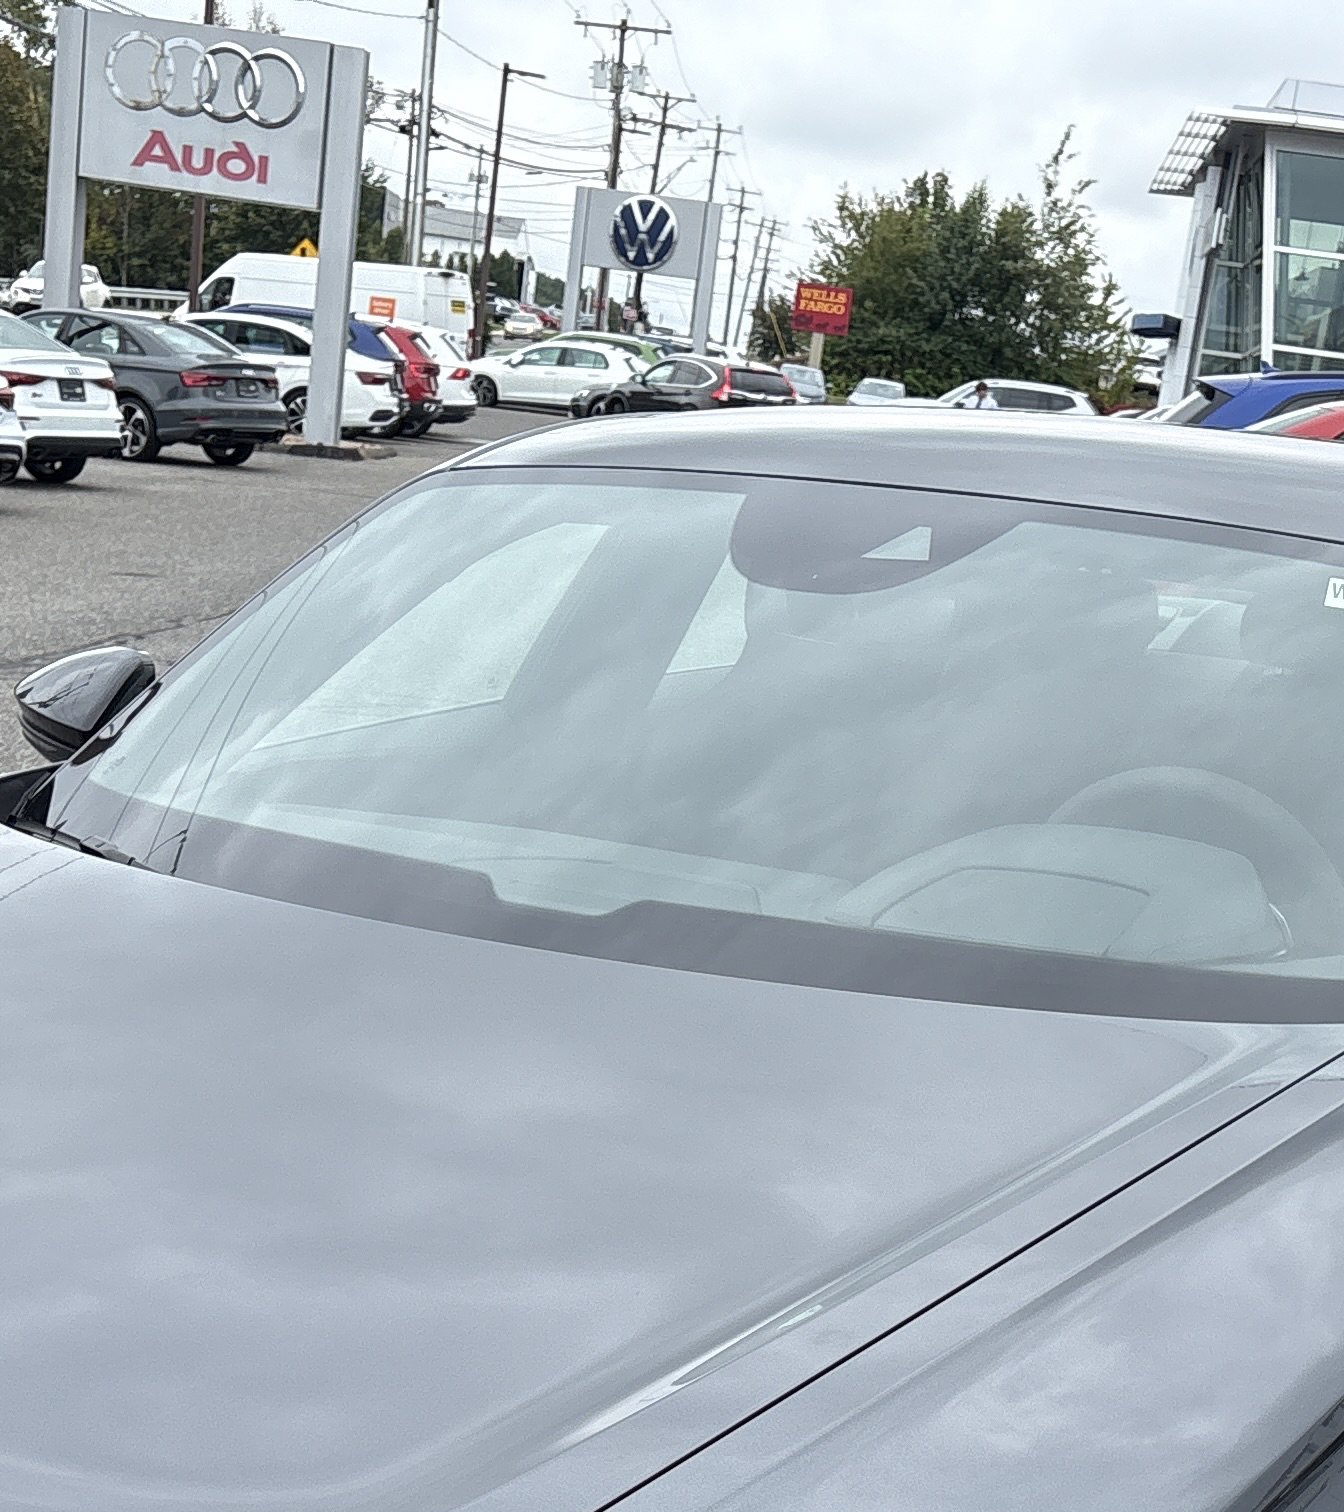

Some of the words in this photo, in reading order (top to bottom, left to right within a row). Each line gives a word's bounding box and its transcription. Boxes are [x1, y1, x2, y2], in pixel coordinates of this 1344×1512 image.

[130, 129, 269, 184] Audi
[799, 287, 848, 304] WELLS
[799, 299, 846, 316] FARGO
